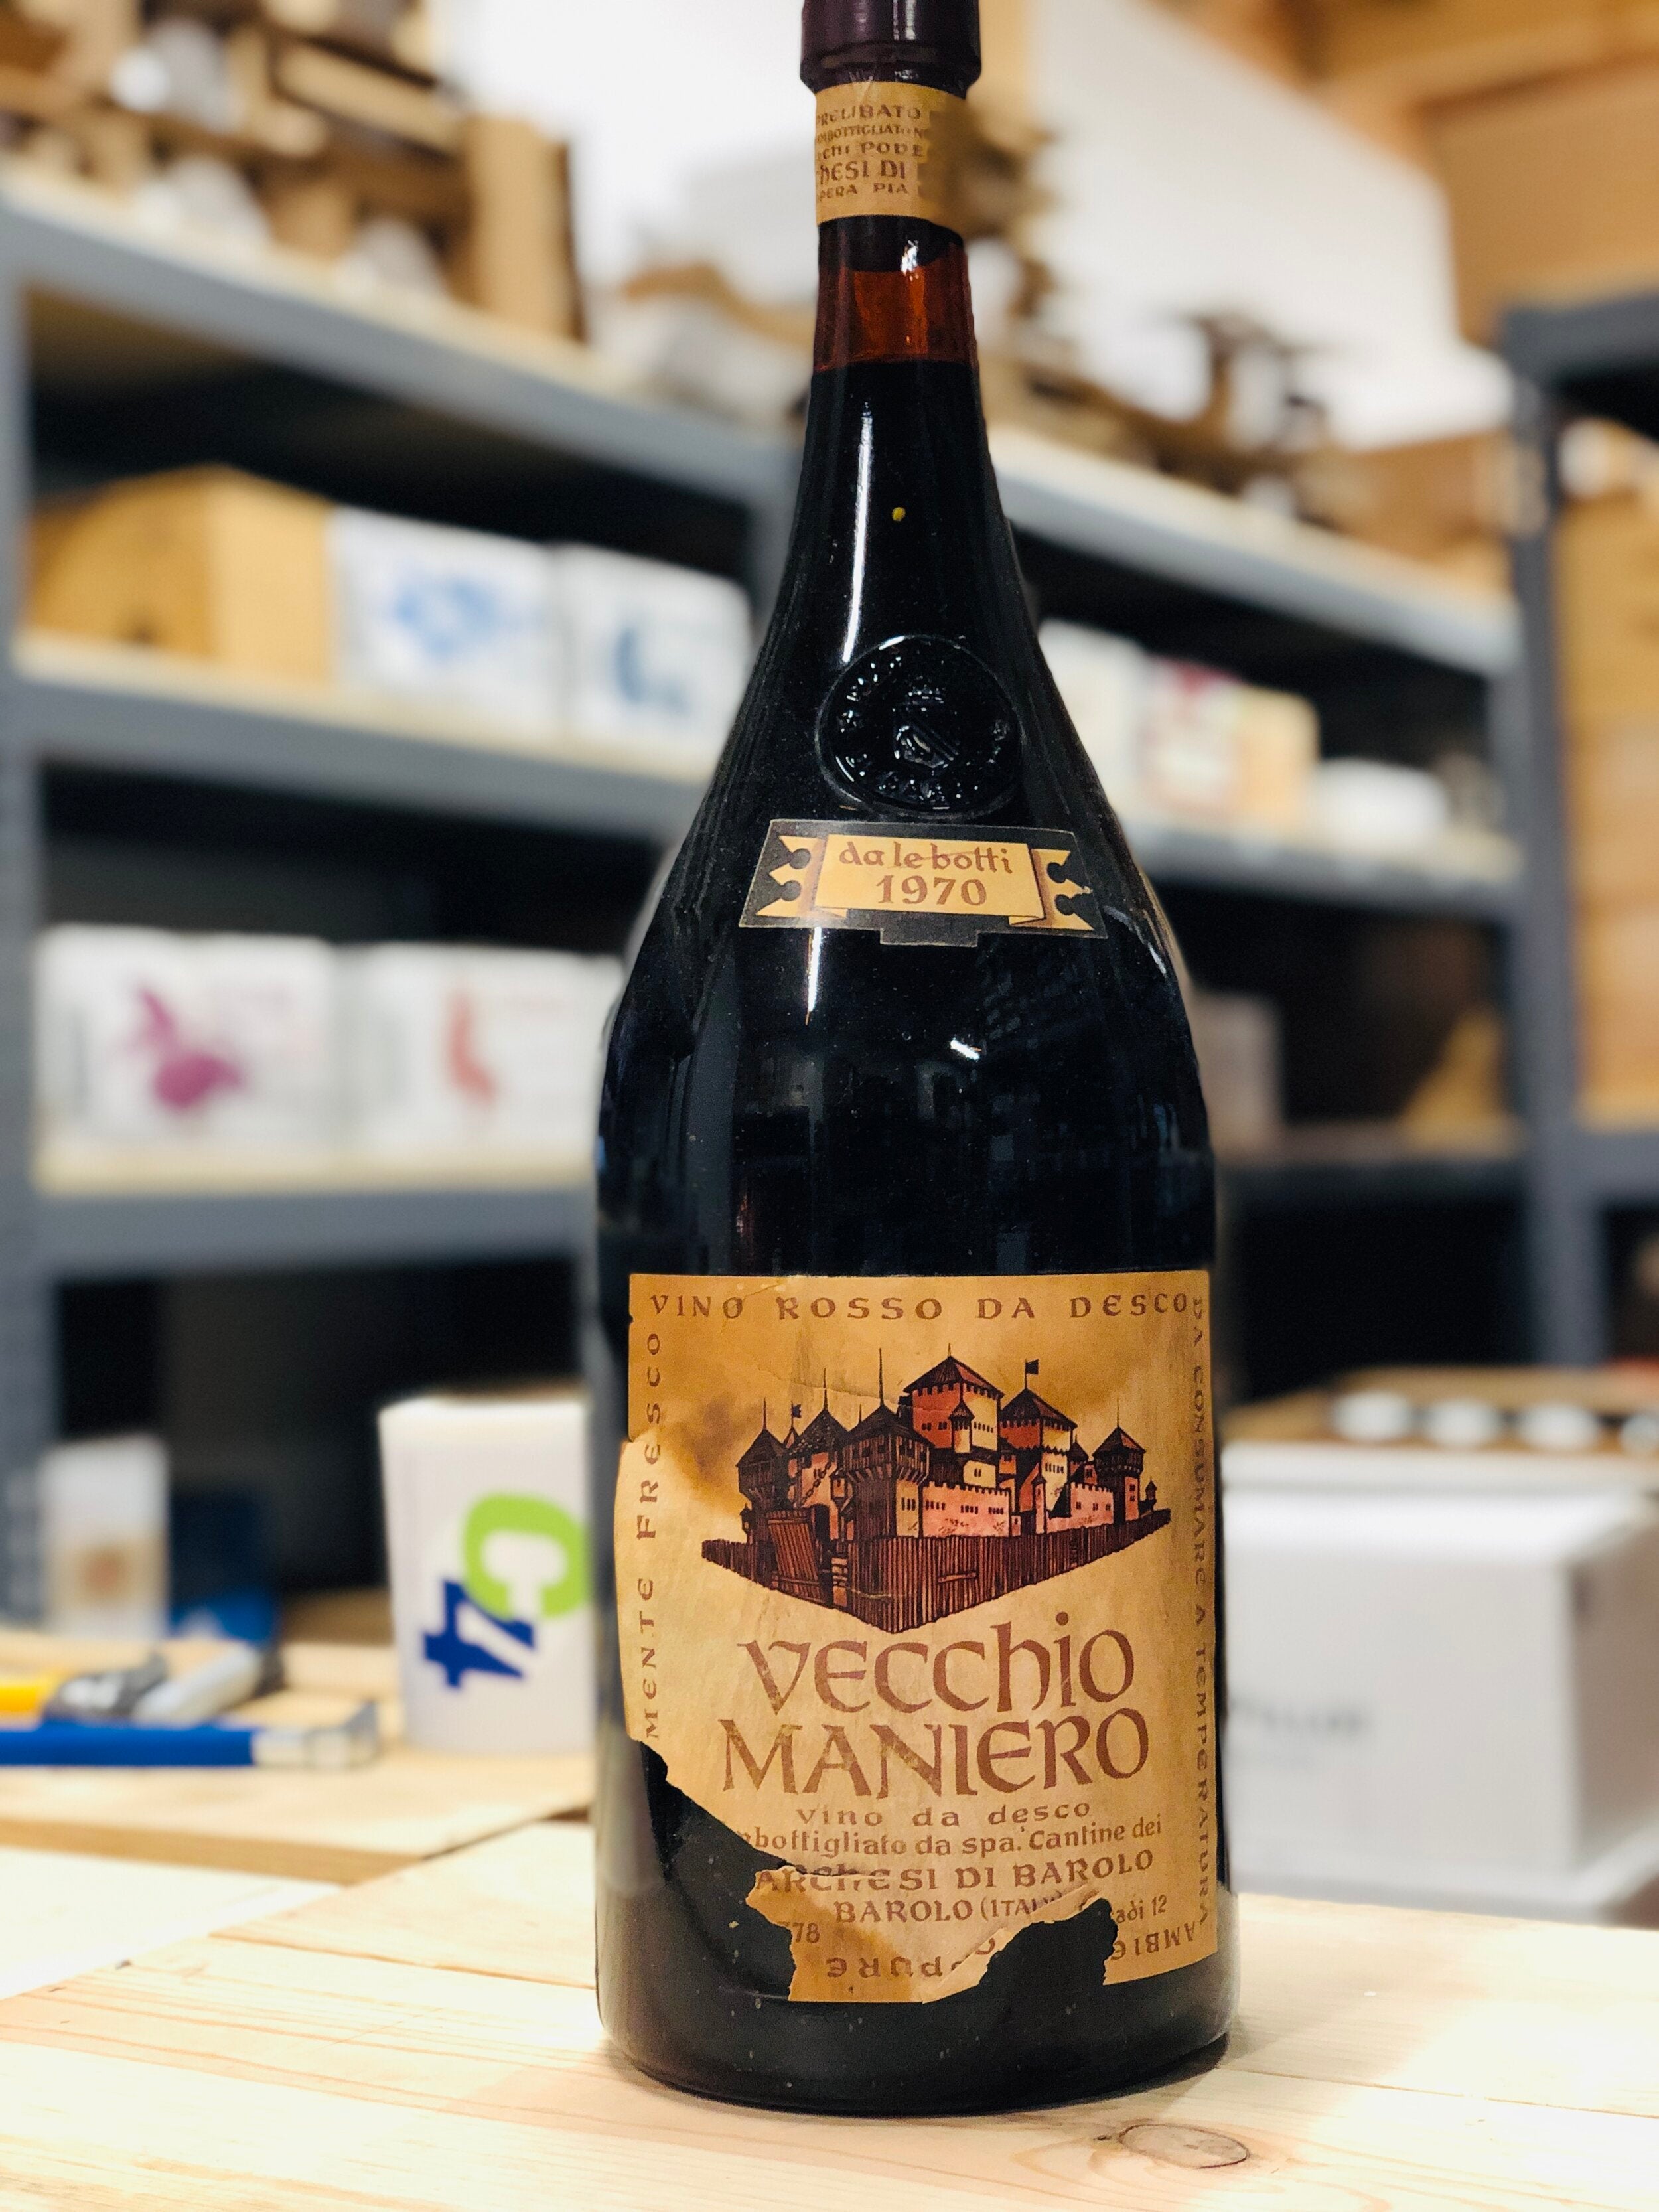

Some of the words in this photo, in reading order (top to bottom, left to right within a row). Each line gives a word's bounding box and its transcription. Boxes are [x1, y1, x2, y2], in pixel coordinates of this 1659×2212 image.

[881, 159, 905, 179] DI
[873, 183, 908, 194] PIA
[930, 844, 1013, 873] botti
[876, 875, 987, 905] 1970
[651, 1294, 743, 1319] VINO
[778, 1293, 942, 1320] ROSSO
[977, 1293, 1037, 1320] DA
[1069, 1291, 1190, 1318] DESCO
[636, 1333, 663, 1540] FRESCO
[636, 1577, 660, 1739] MENTE
[717, 1707, 1149, 1800] MANIERO
[1196, 1644, 1209, 1926] TEMPERATURA
[796, 1804, 883, 1826] vino
[912, 1807, 960, 1827] da
[987, 1801, 1090, 1825] desco
[914, 1834, 951, 1856] da
[1029, 1822, 1125, 1850] Cantine
[1131, 1812, 1162, 1840] dei
[954, 1866, 997, 1890] DI
[1012, 1848, 1153, 1888] BAROLO
[833, 1899, 974, 1923] BAROLO
[1151, 1894, 1168, 1915] 12
